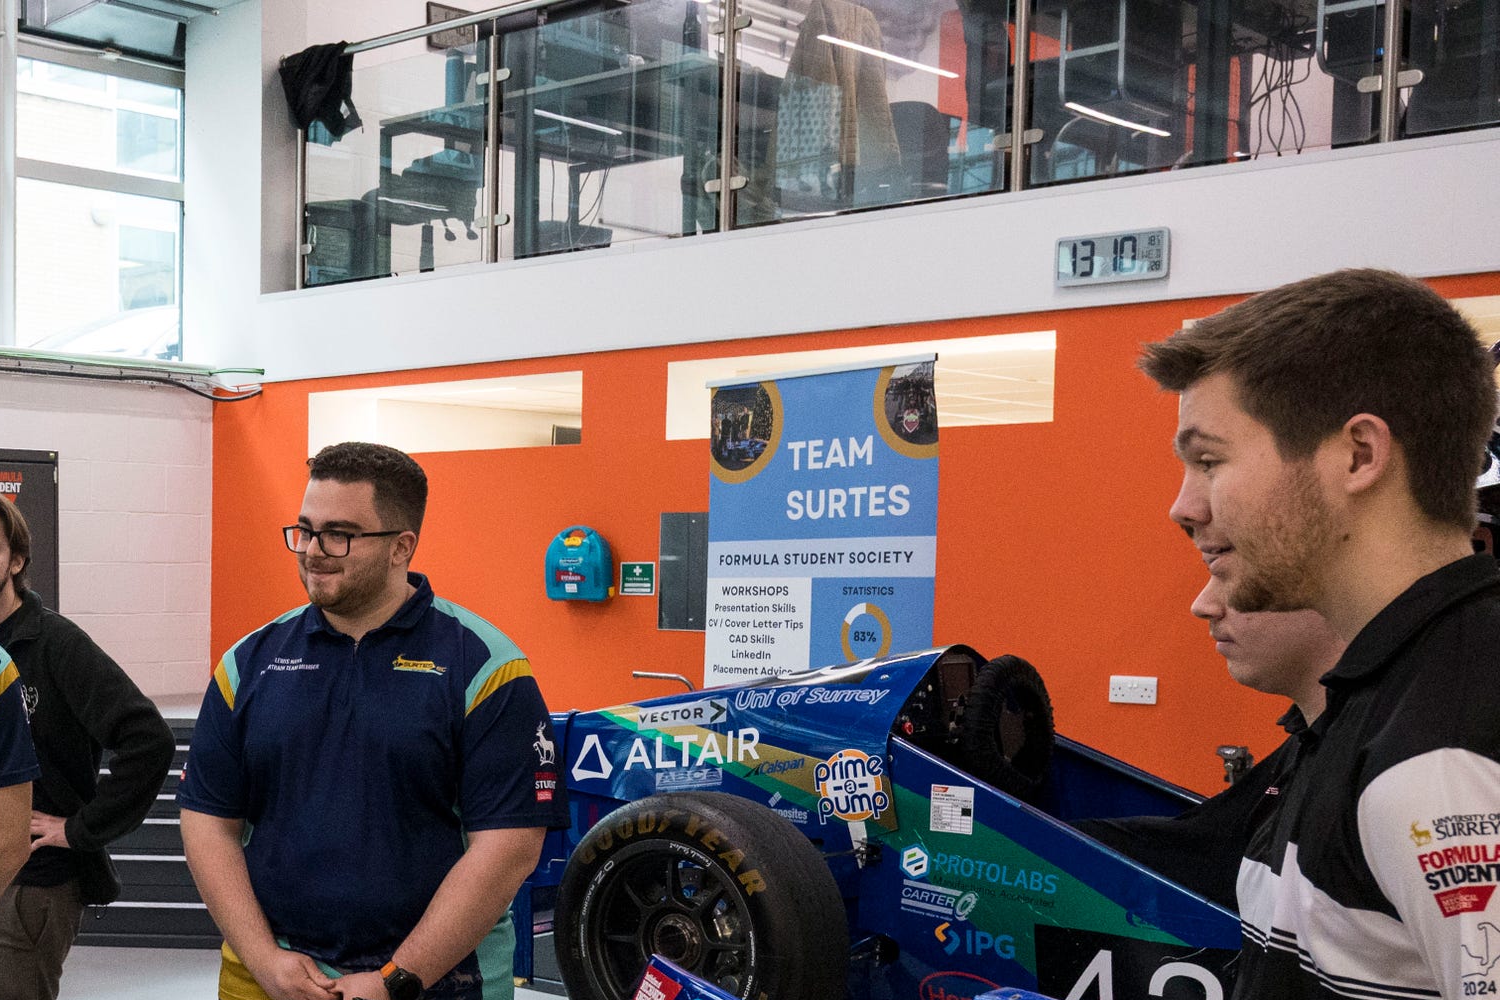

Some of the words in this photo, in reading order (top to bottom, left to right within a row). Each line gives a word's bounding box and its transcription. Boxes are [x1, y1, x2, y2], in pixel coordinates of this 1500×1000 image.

[788, 435, 874, 471] TEAM
[786, 484, 911, 520] SURTES
[719, 554, 779, 566] FORMULA
[784, 552, 845, 564] STUDENT
[849, 551, 914, 564] SOCIETY
[722, 586, 789, 597] WORKSHOPS
[842, 586, 894, 596] STATISTICS
[714, 603, 770, 613] Presentation
[772, 603, 796, 613] Skills
[708, 618, 718, 628] CV
[725, 619, 750, 629] Cover
[752, 620, 782, 630] Letter
[786, 620, 804, 631] Tips
[729, 634, 748, 644] CAD
[750, 634, 775, 644] Skills
[854, 631, 876, 643] 83%
[732, 650, 772, 660] LinkedIn
[713, 664, 759, 676] Placement
[735, 690, 777, 711] Uni
[780, 688, 801, 706] of
[805, 688, 890, 704] Surrey
[639, 708, 704, 724] VECTOR
[624, 728, 760, 771] ALTAIR
[761, 758, 805, 774] Calspan
[814, 755, 882, 792] prime
[818, 789, 889, 824] pump
[1435, 821, 1500, 840] SURREY
[1418, 844, 1500, 873] FORMULA
[935, 852, 1059, 894] PROTOLABS
[902, 887, 956, 908] CARTER
[966, 929, 1015, 959] IPG
[1464, 980, 1496, 996] 2024
